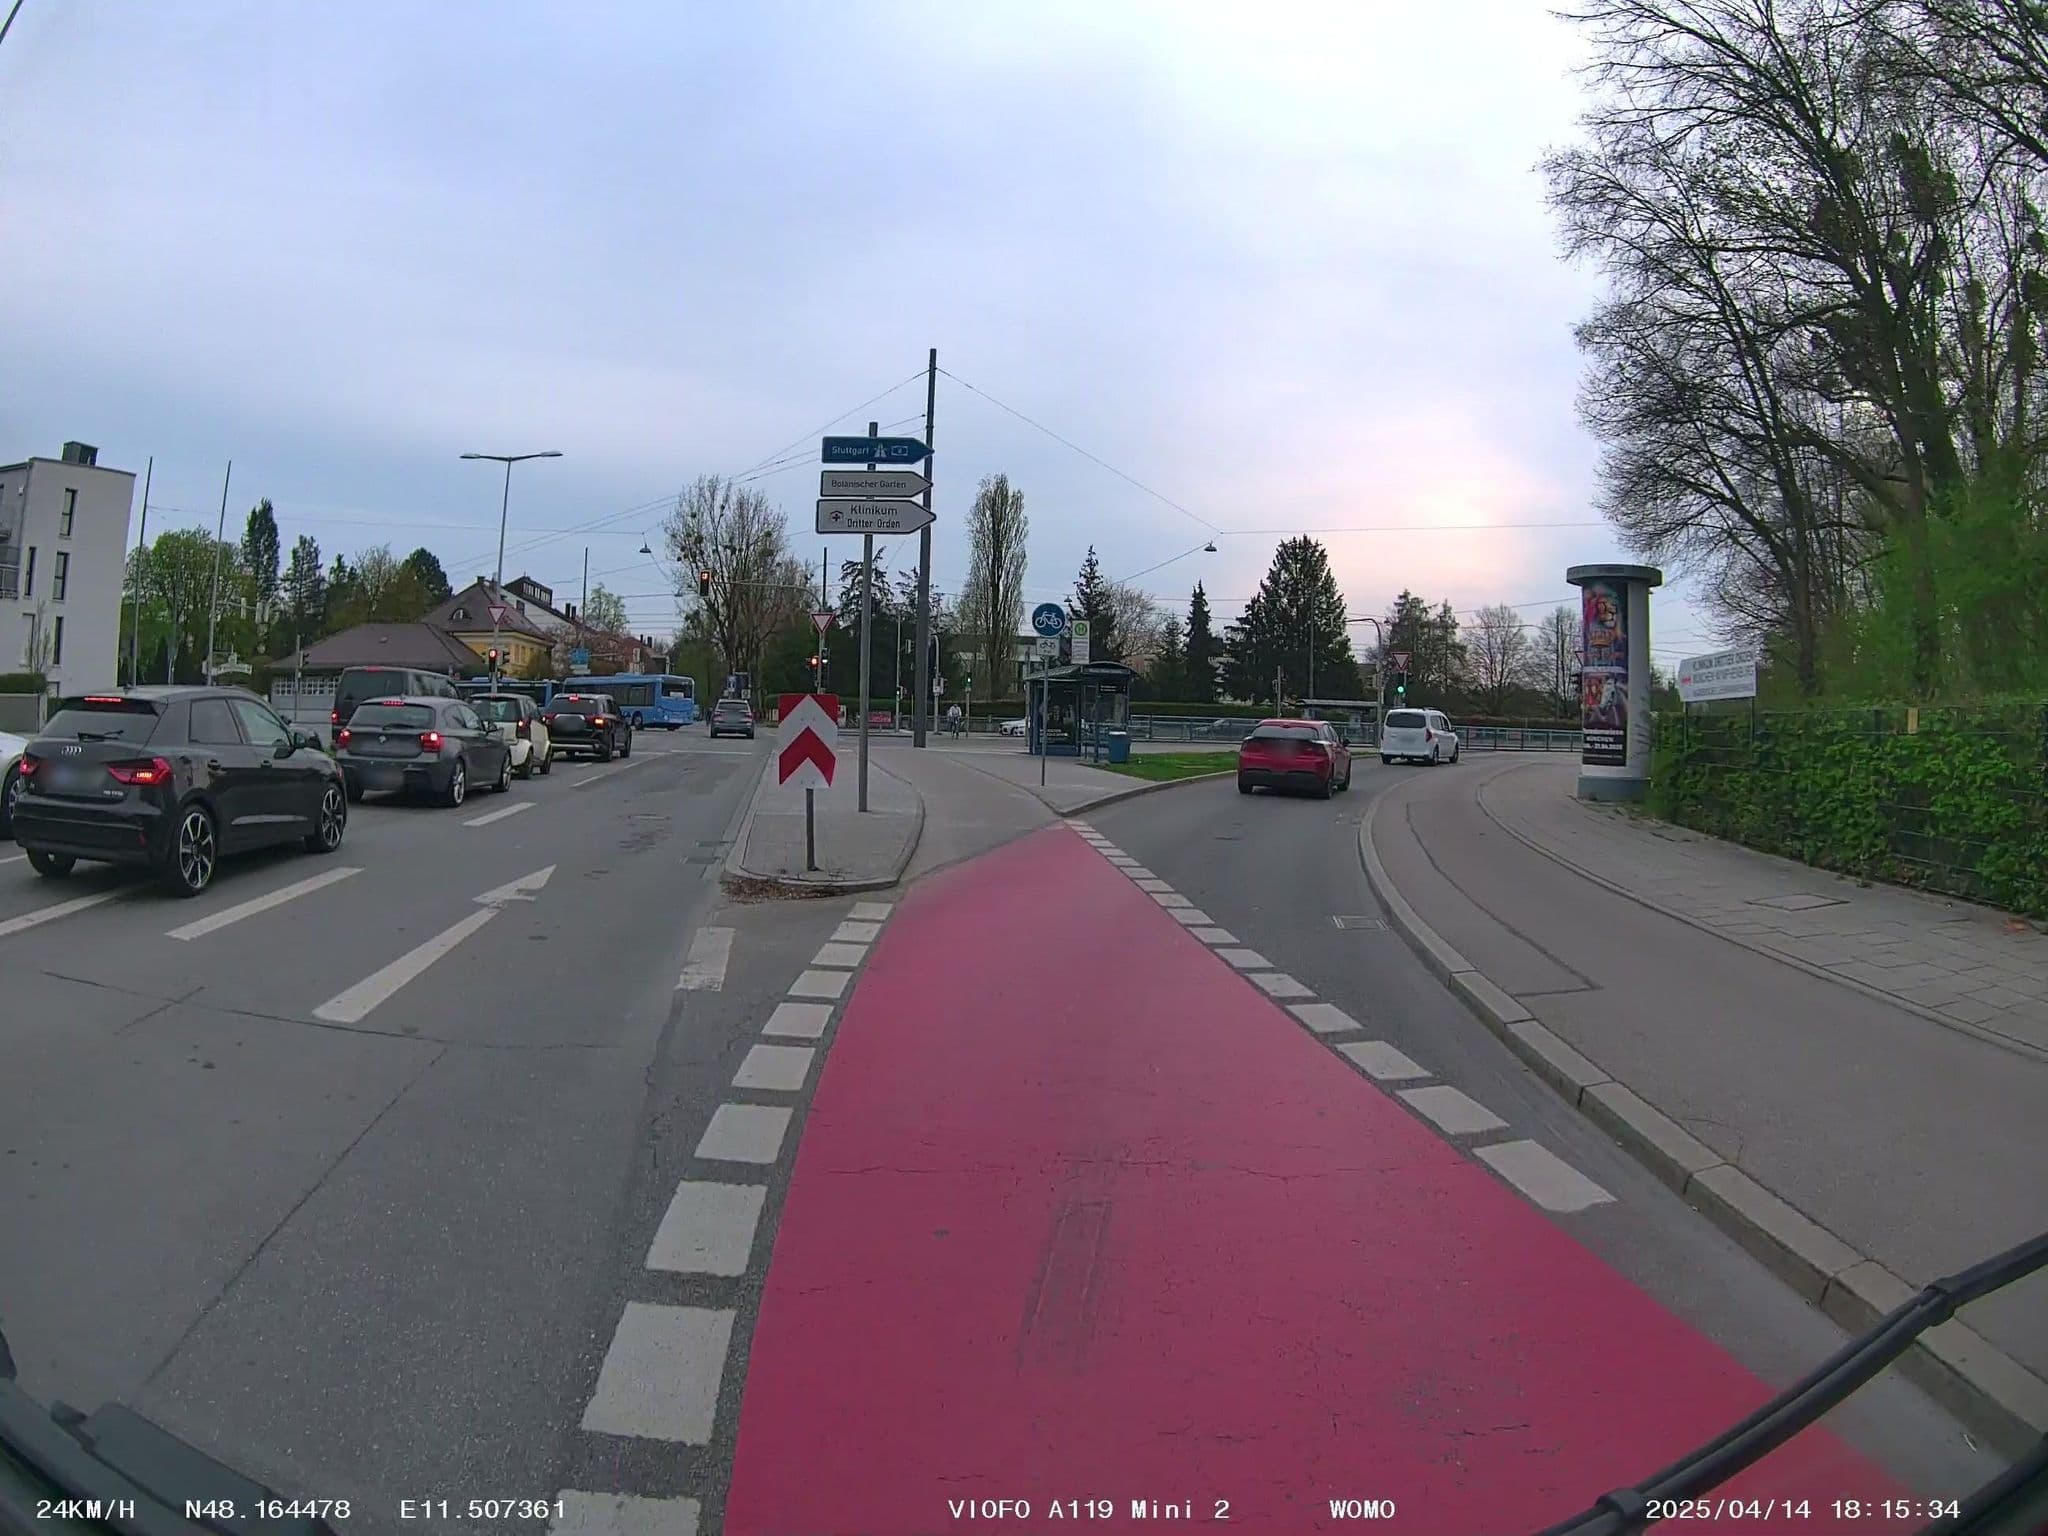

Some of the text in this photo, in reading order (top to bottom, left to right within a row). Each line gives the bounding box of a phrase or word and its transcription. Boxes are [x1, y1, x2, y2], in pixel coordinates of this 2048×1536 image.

[831, 445, 869, 456] Stuttgart
[831, 479, 906, 488] Botanischer Garten
[850, 504, 898, 516] Klinikum
[847, 518, 901, 528] Dritter Orden
